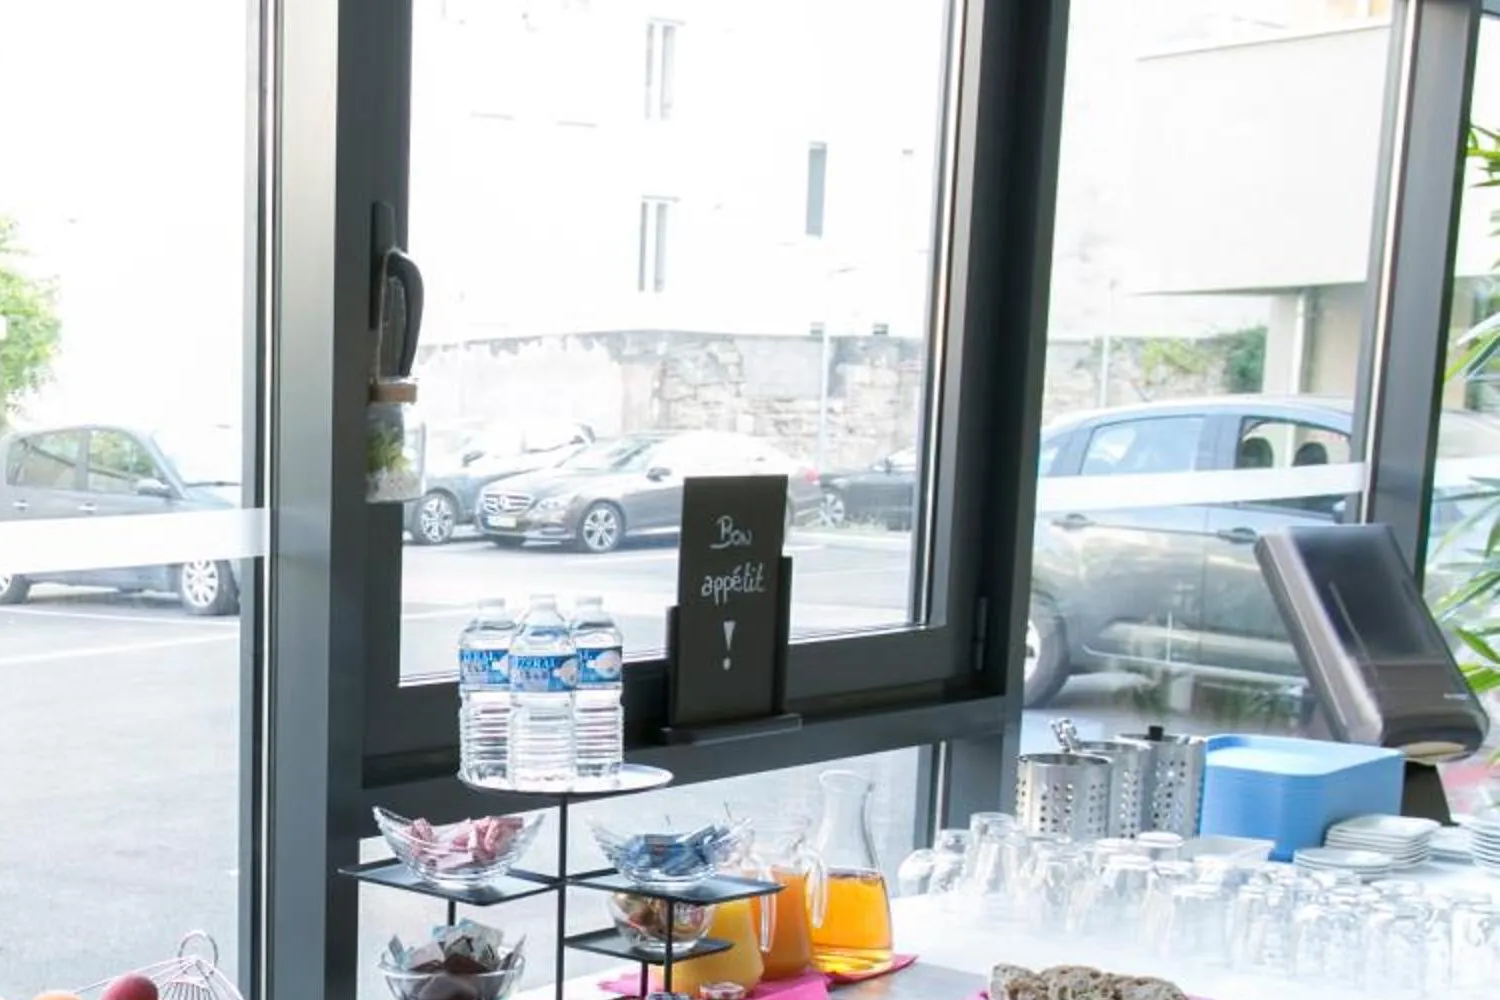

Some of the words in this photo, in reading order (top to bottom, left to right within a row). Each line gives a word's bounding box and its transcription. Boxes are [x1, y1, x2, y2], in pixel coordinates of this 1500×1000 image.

[709, 515, 752, 549] Bon
[701, 562, 766, 606] appétit
[722, 620, 736, 671] !
